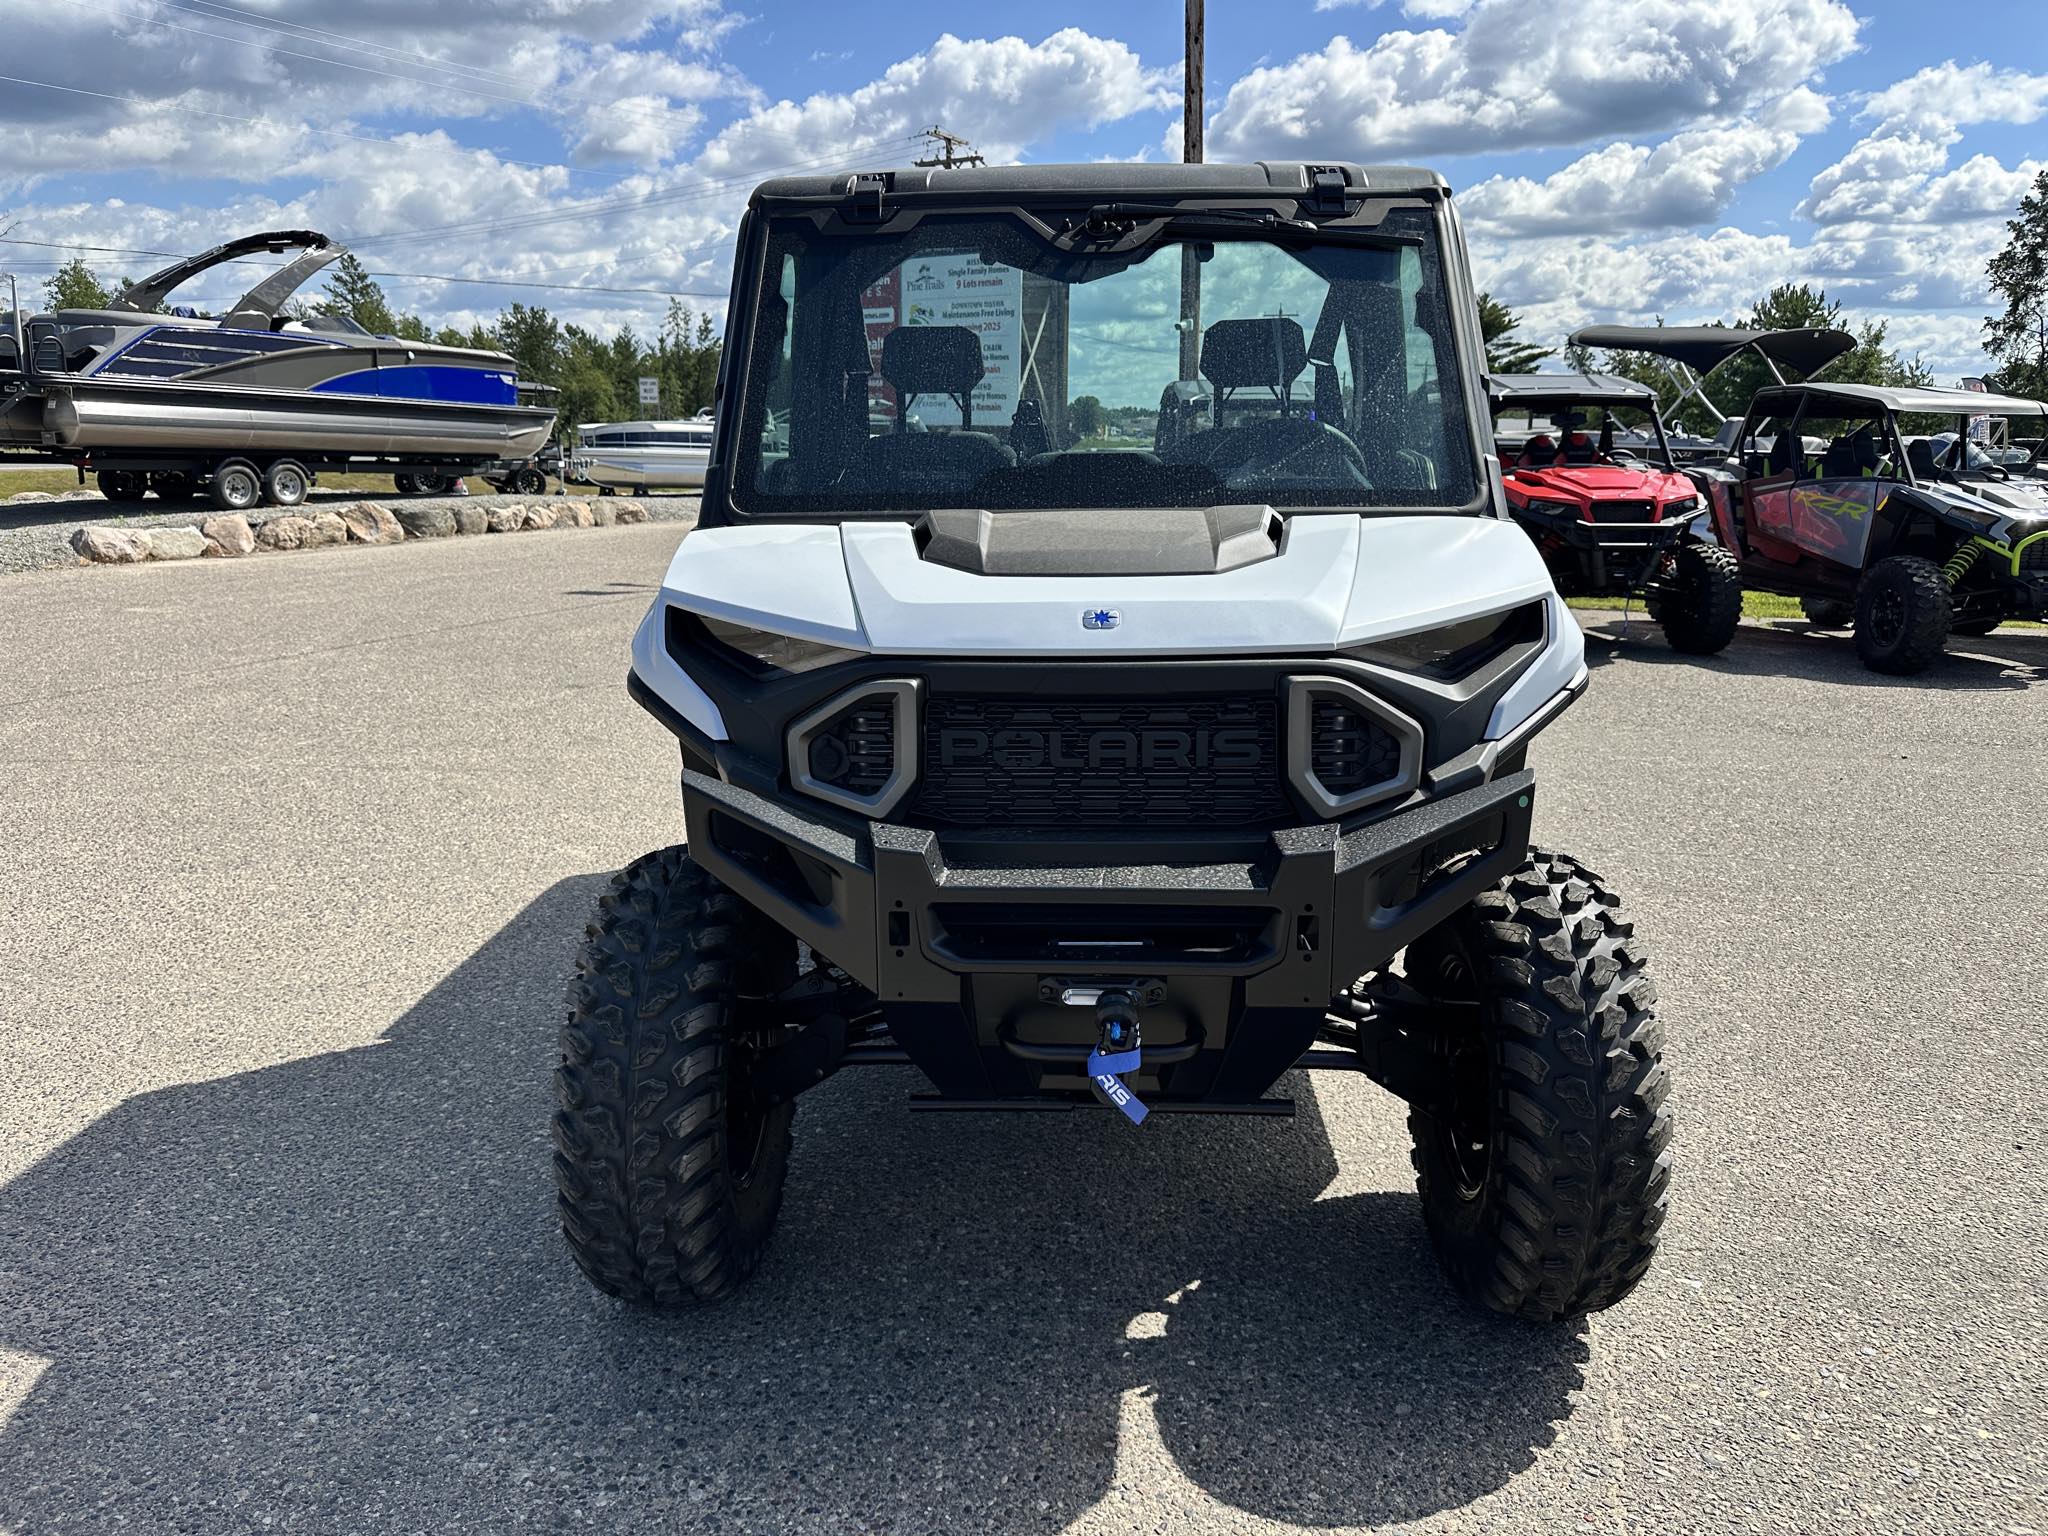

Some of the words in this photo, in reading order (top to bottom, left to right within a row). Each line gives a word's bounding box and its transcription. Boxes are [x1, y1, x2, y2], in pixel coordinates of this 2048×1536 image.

[948, 269, 966, 277] Single
[967, 267, 987, 276] Family
[988, 266, 1010, 274] Homes
[906, 281, 922, 292] Pine
[924, 279, 945, 290] Trails
[956, 280, 962, 289] 9
[963, 280, 977, 289] Lots
[978, 278, 1003, 287] remain
[942, 311, 980, 319] Maintenance
[981, 309, 995, 318] Free
[995, 308, 1015, 318] Living
[941, 730, 1263, 768] POLARIS
[1097, 1074, 1131, 1106] RIS
